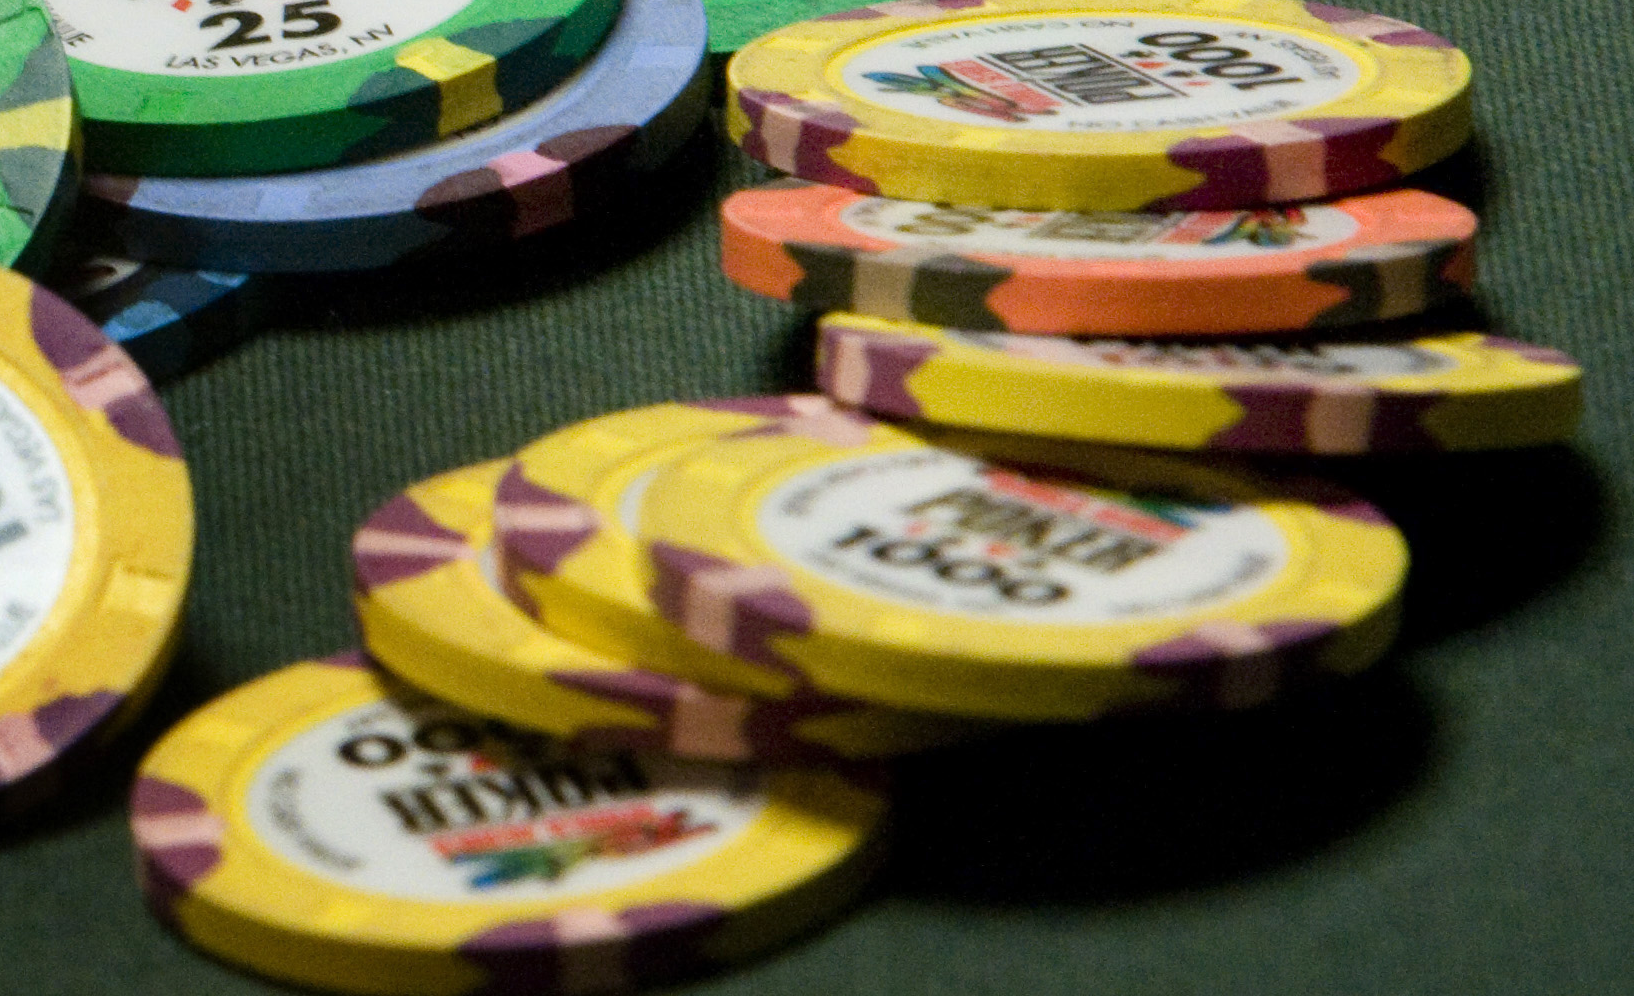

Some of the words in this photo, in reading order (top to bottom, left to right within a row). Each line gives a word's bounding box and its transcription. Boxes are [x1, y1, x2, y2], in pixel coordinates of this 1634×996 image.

[166, 51, 223, 72] LAS
[350, 22, 397, 48] NV
[989, 44, 1177, 105] POKER
[1137, 30, 1304, 91] 1000
